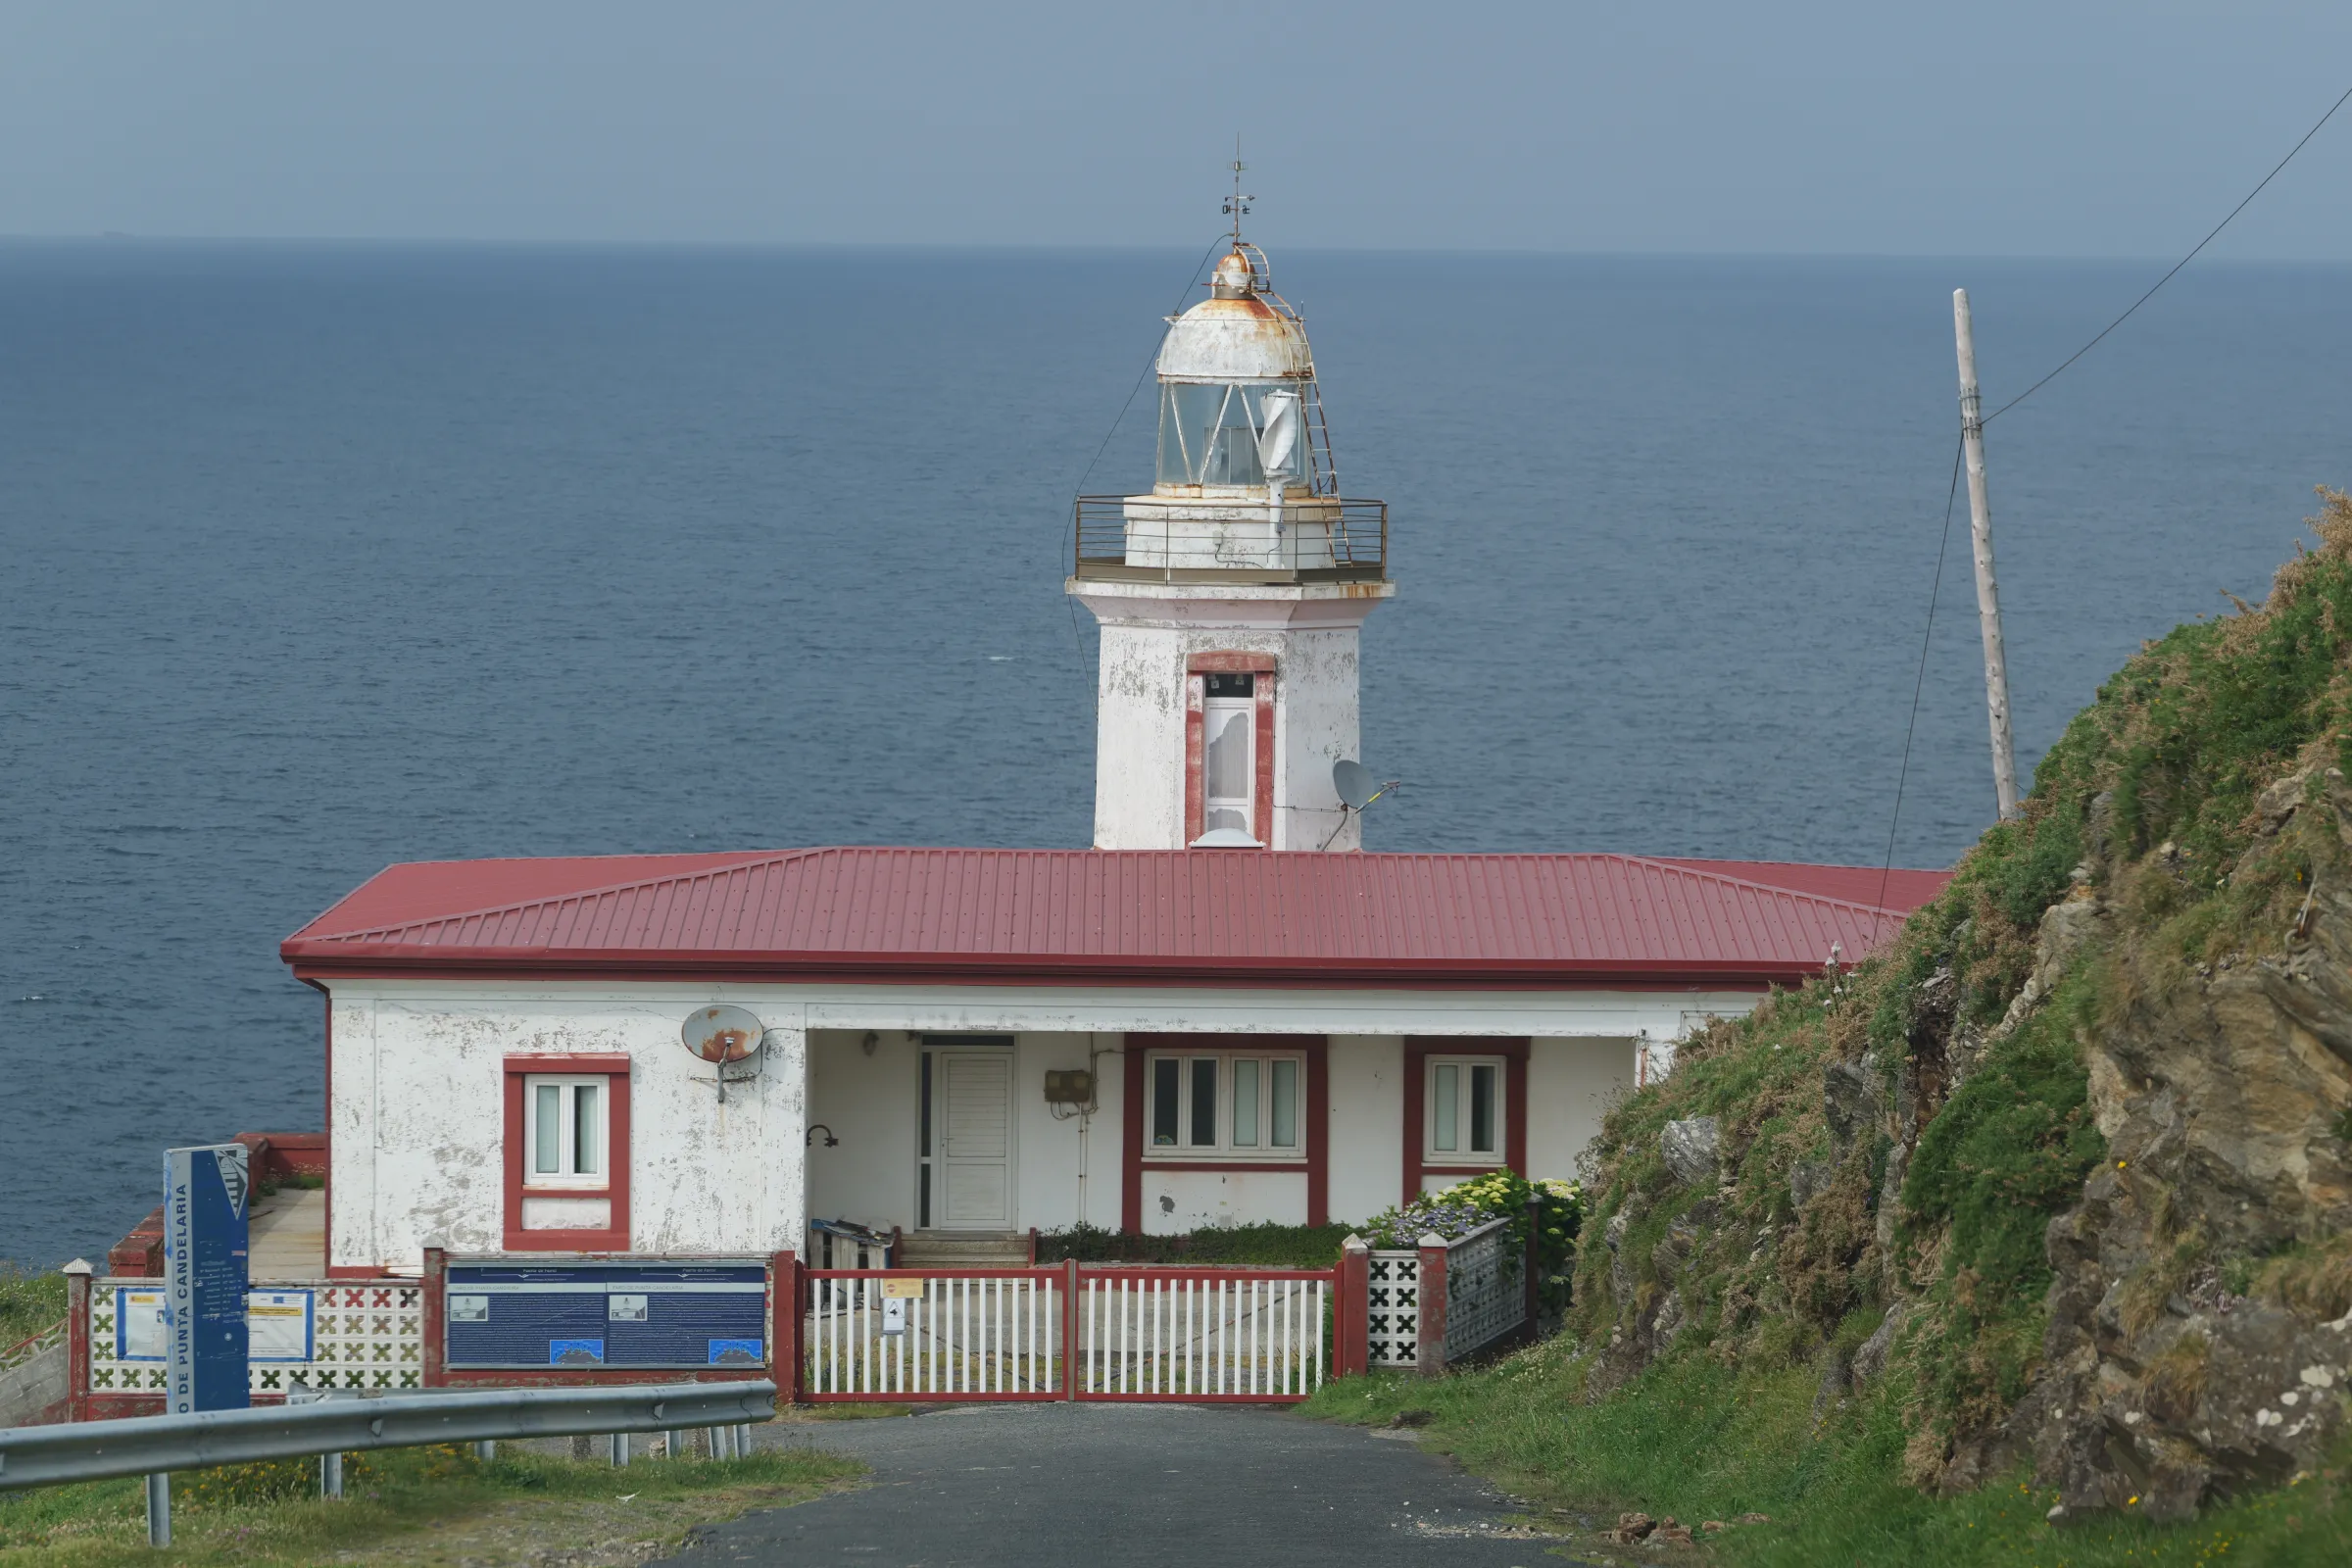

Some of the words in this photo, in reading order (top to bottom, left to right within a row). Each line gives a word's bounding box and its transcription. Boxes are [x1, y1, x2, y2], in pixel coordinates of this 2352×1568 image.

[175, 1184, 188, 1299] CANDELARIA
[177, 1305, 189, 1365] PUNTA
[178, 1372, 189, 1395] DE
